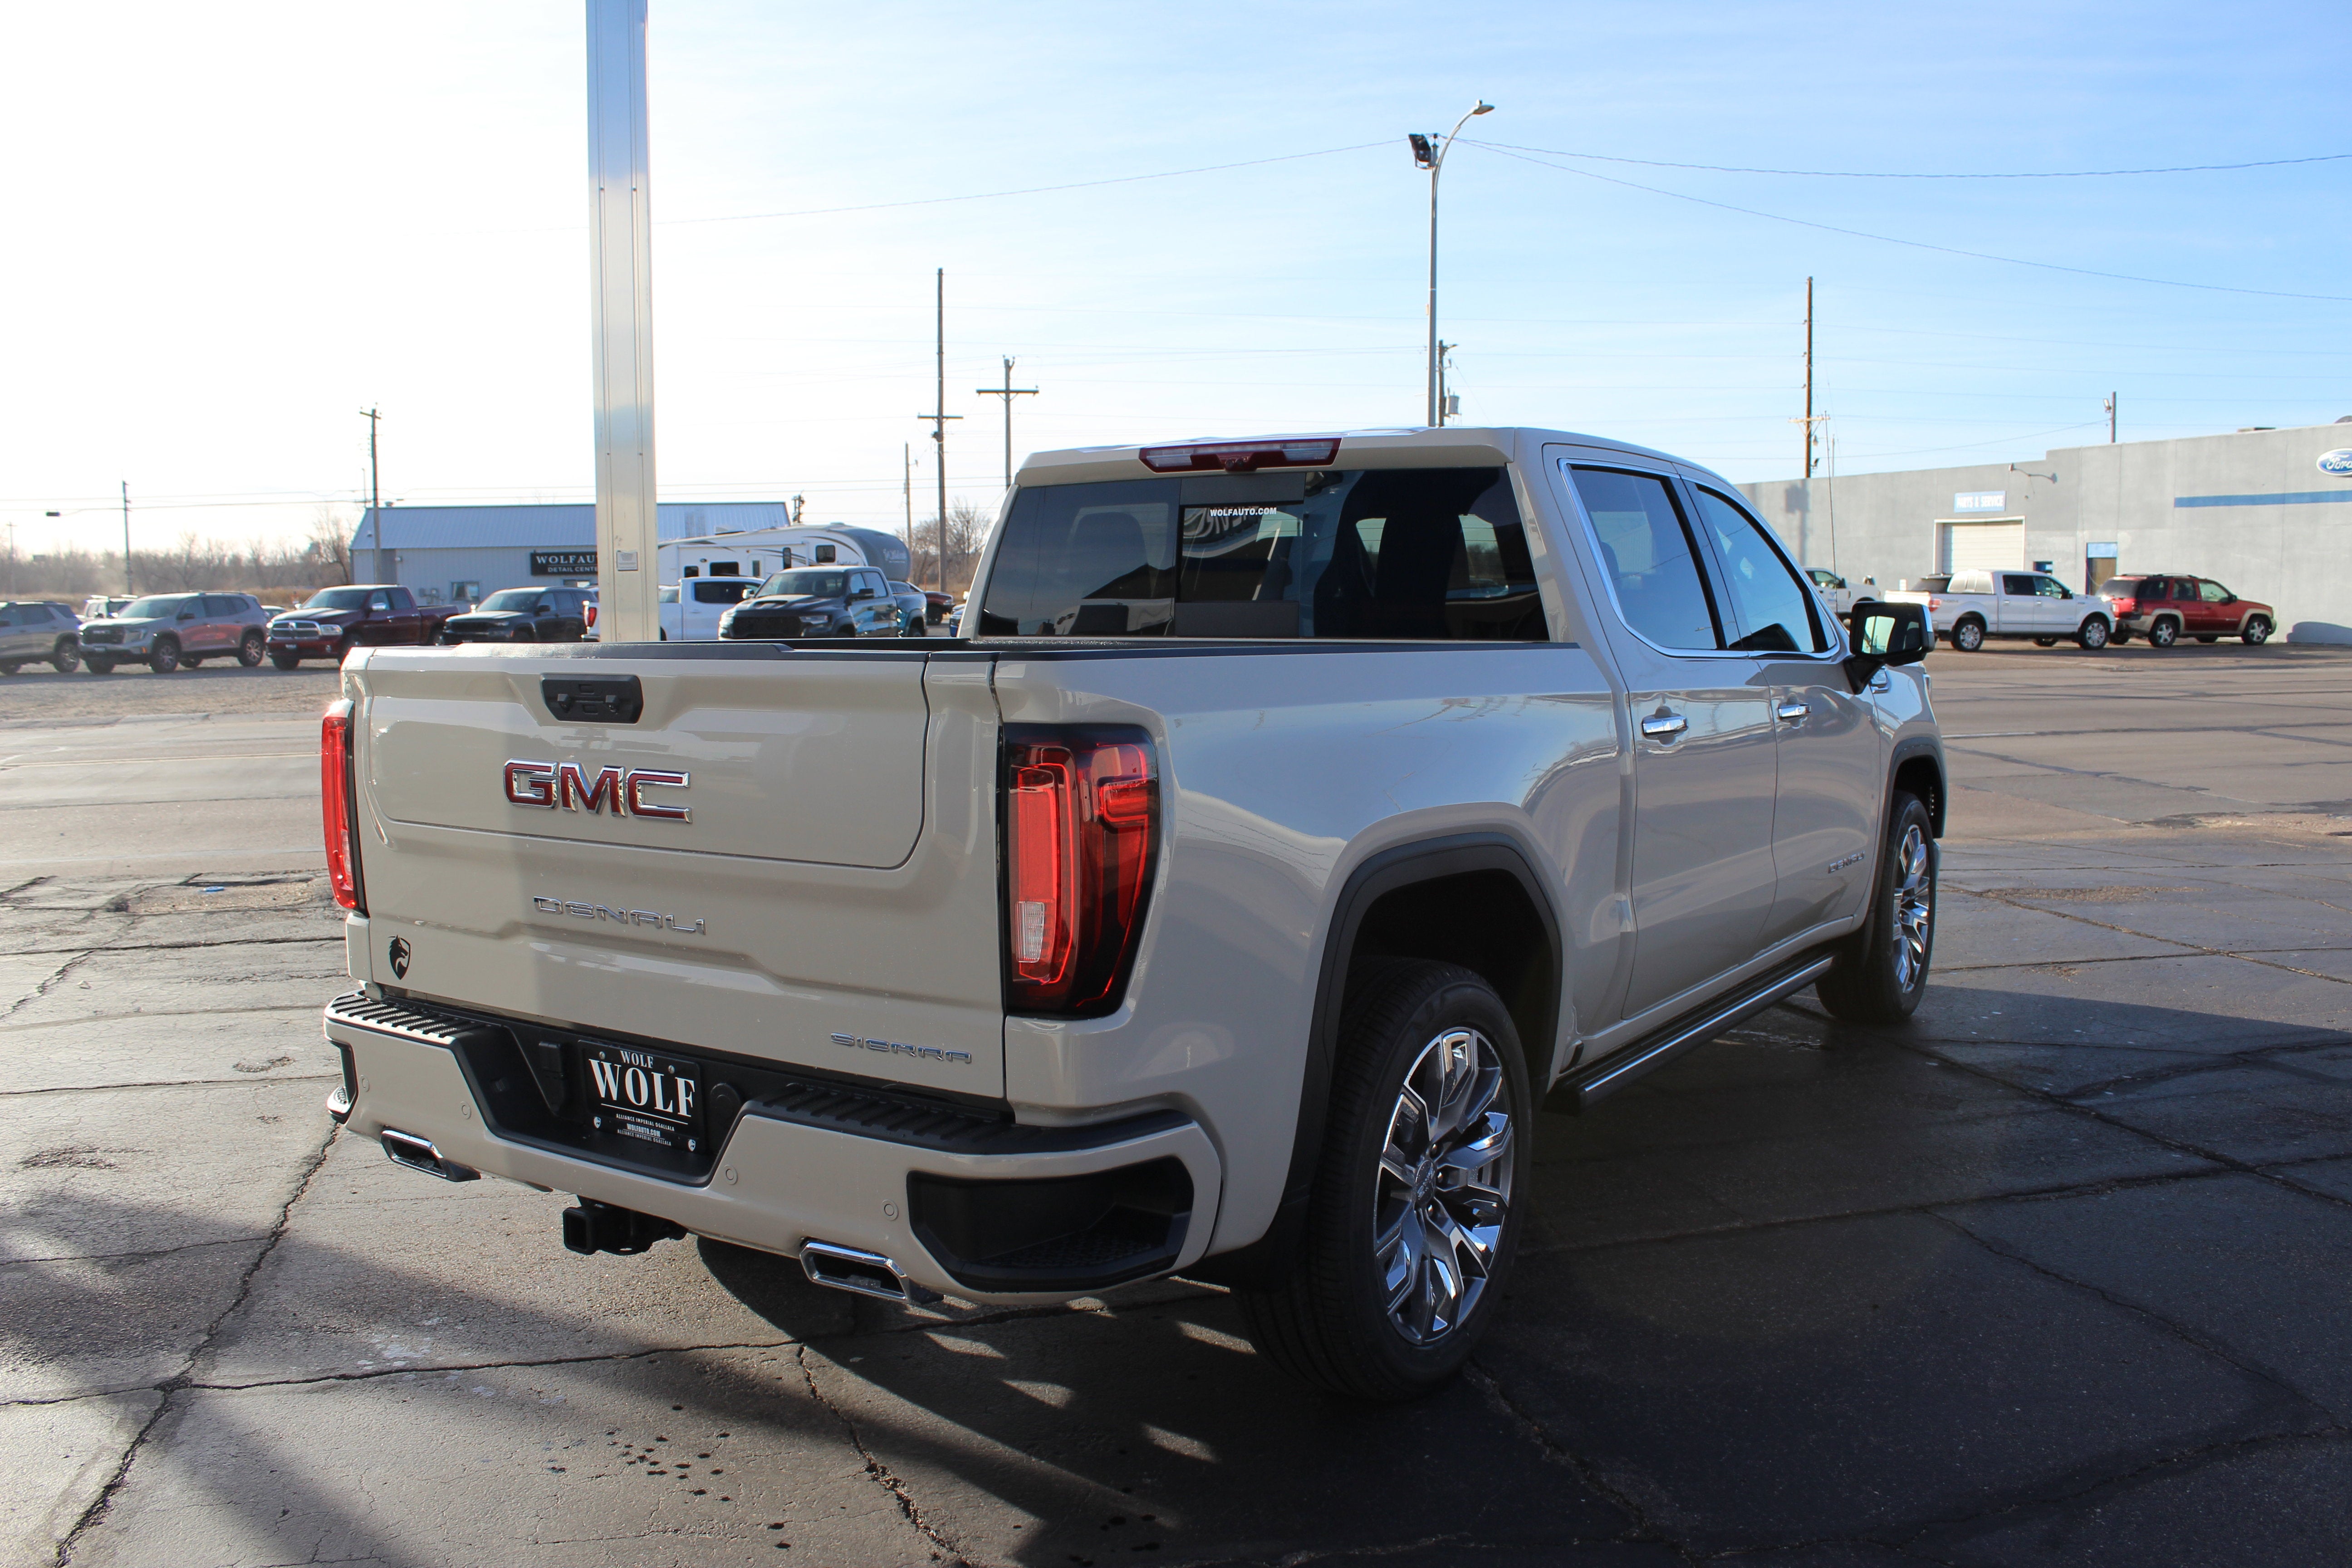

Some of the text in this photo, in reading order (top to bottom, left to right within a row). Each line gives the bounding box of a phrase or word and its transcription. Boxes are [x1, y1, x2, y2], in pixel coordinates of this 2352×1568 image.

[1956, 495, 2003, 509] PARTS & SERVICE
[1210, 507, 1277, 516] WOLFAUTO.COM
[536, 555, 597, 564] WOLFAU
[504, 758, 693, 823] GMC
[534, 896, 706, 935] DENALI
[831, 1032, 972, 1064] SIERRA
[620, 1050, 653, 1068] WOLF
[588, 1058, 695, 1117] WOLF
[616, 1113, 675, 1132] ALLIANCE IMPERIAL OGALLALA
[627, 1123, 661, 1137] WOLFAUTO.COM
[617, 1129, 671, 1146] ALLIANCE IMPERIAL OGALLALA
